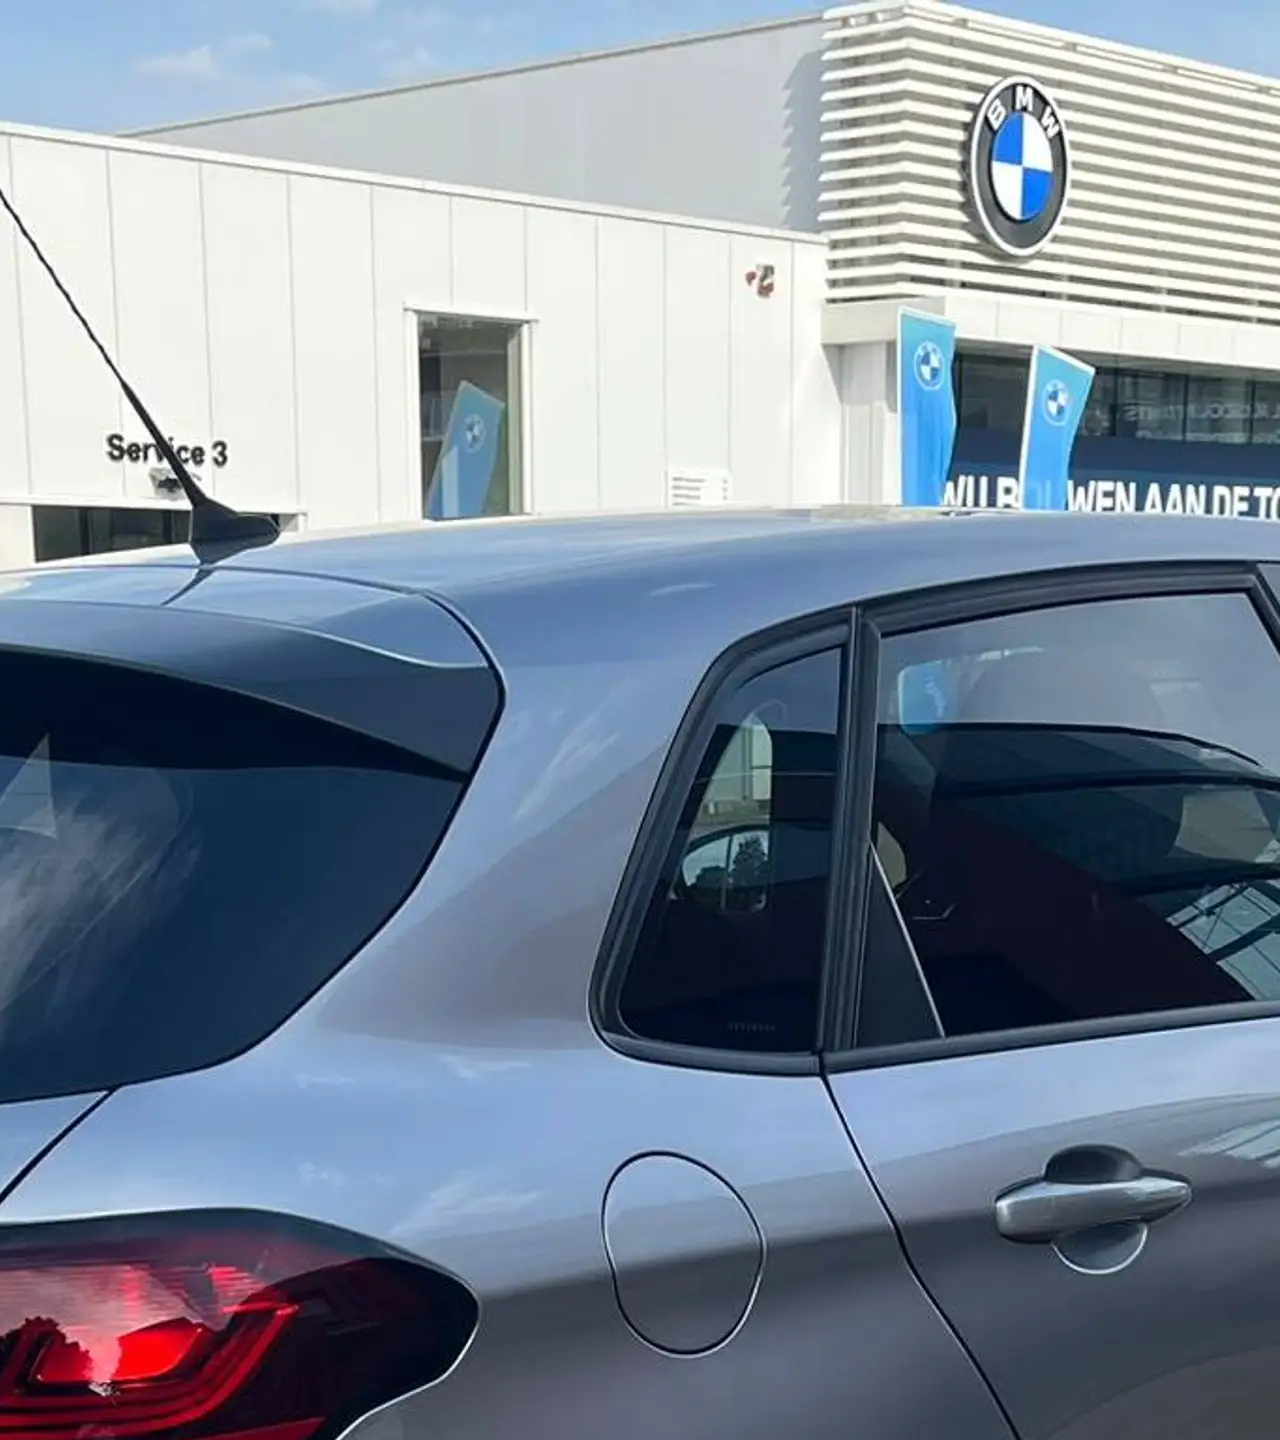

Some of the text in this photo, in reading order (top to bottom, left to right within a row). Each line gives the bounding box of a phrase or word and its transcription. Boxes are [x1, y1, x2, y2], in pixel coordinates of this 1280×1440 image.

[987, 85, 1061, 139] BMW
[106, 433, 228, 468] Service 3
[1144, 482, 1206, 516] AAN
